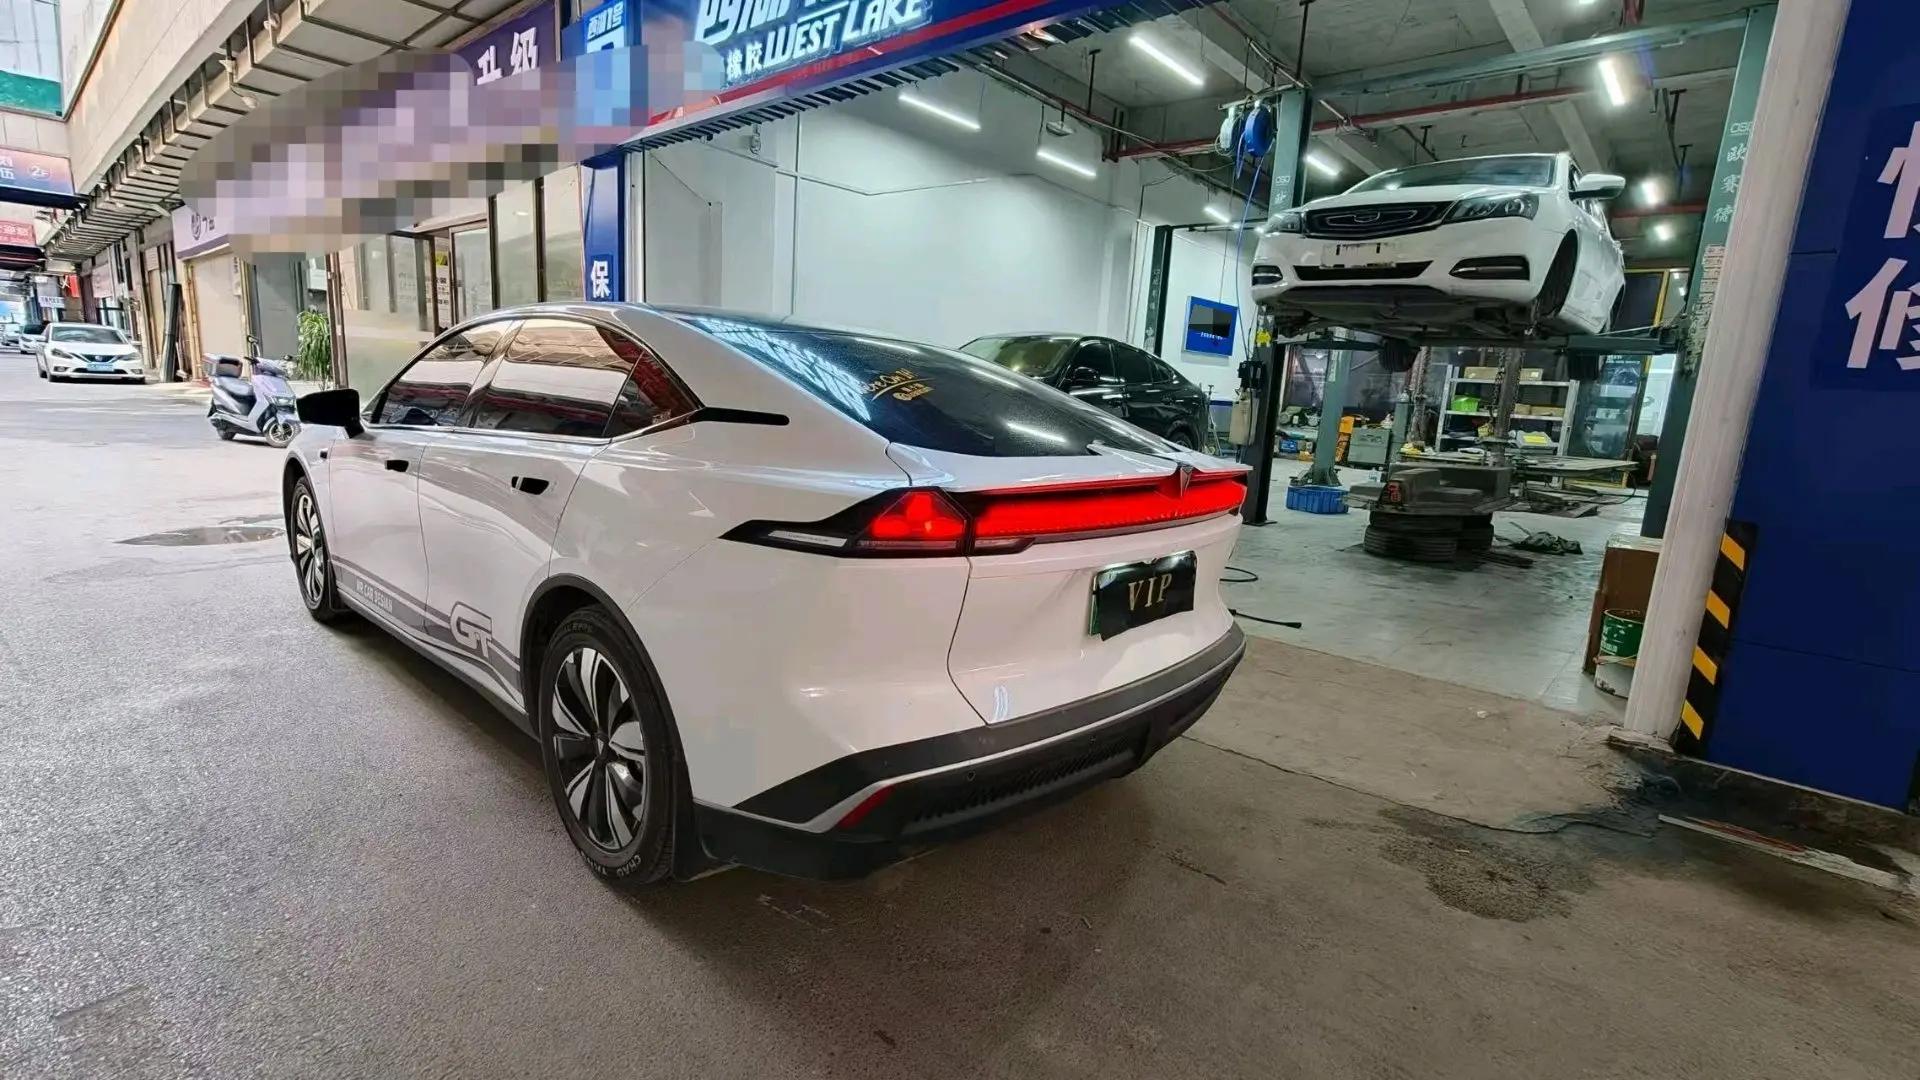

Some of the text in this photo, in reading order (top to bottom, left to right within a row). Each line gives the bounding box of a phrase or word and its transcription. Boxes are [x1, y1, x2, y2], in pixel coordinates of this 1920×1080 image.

[590, 260, 611, 298] 保
[1128, 573, 1172, 610] VIP
[450, 600, 492, 658] GT
